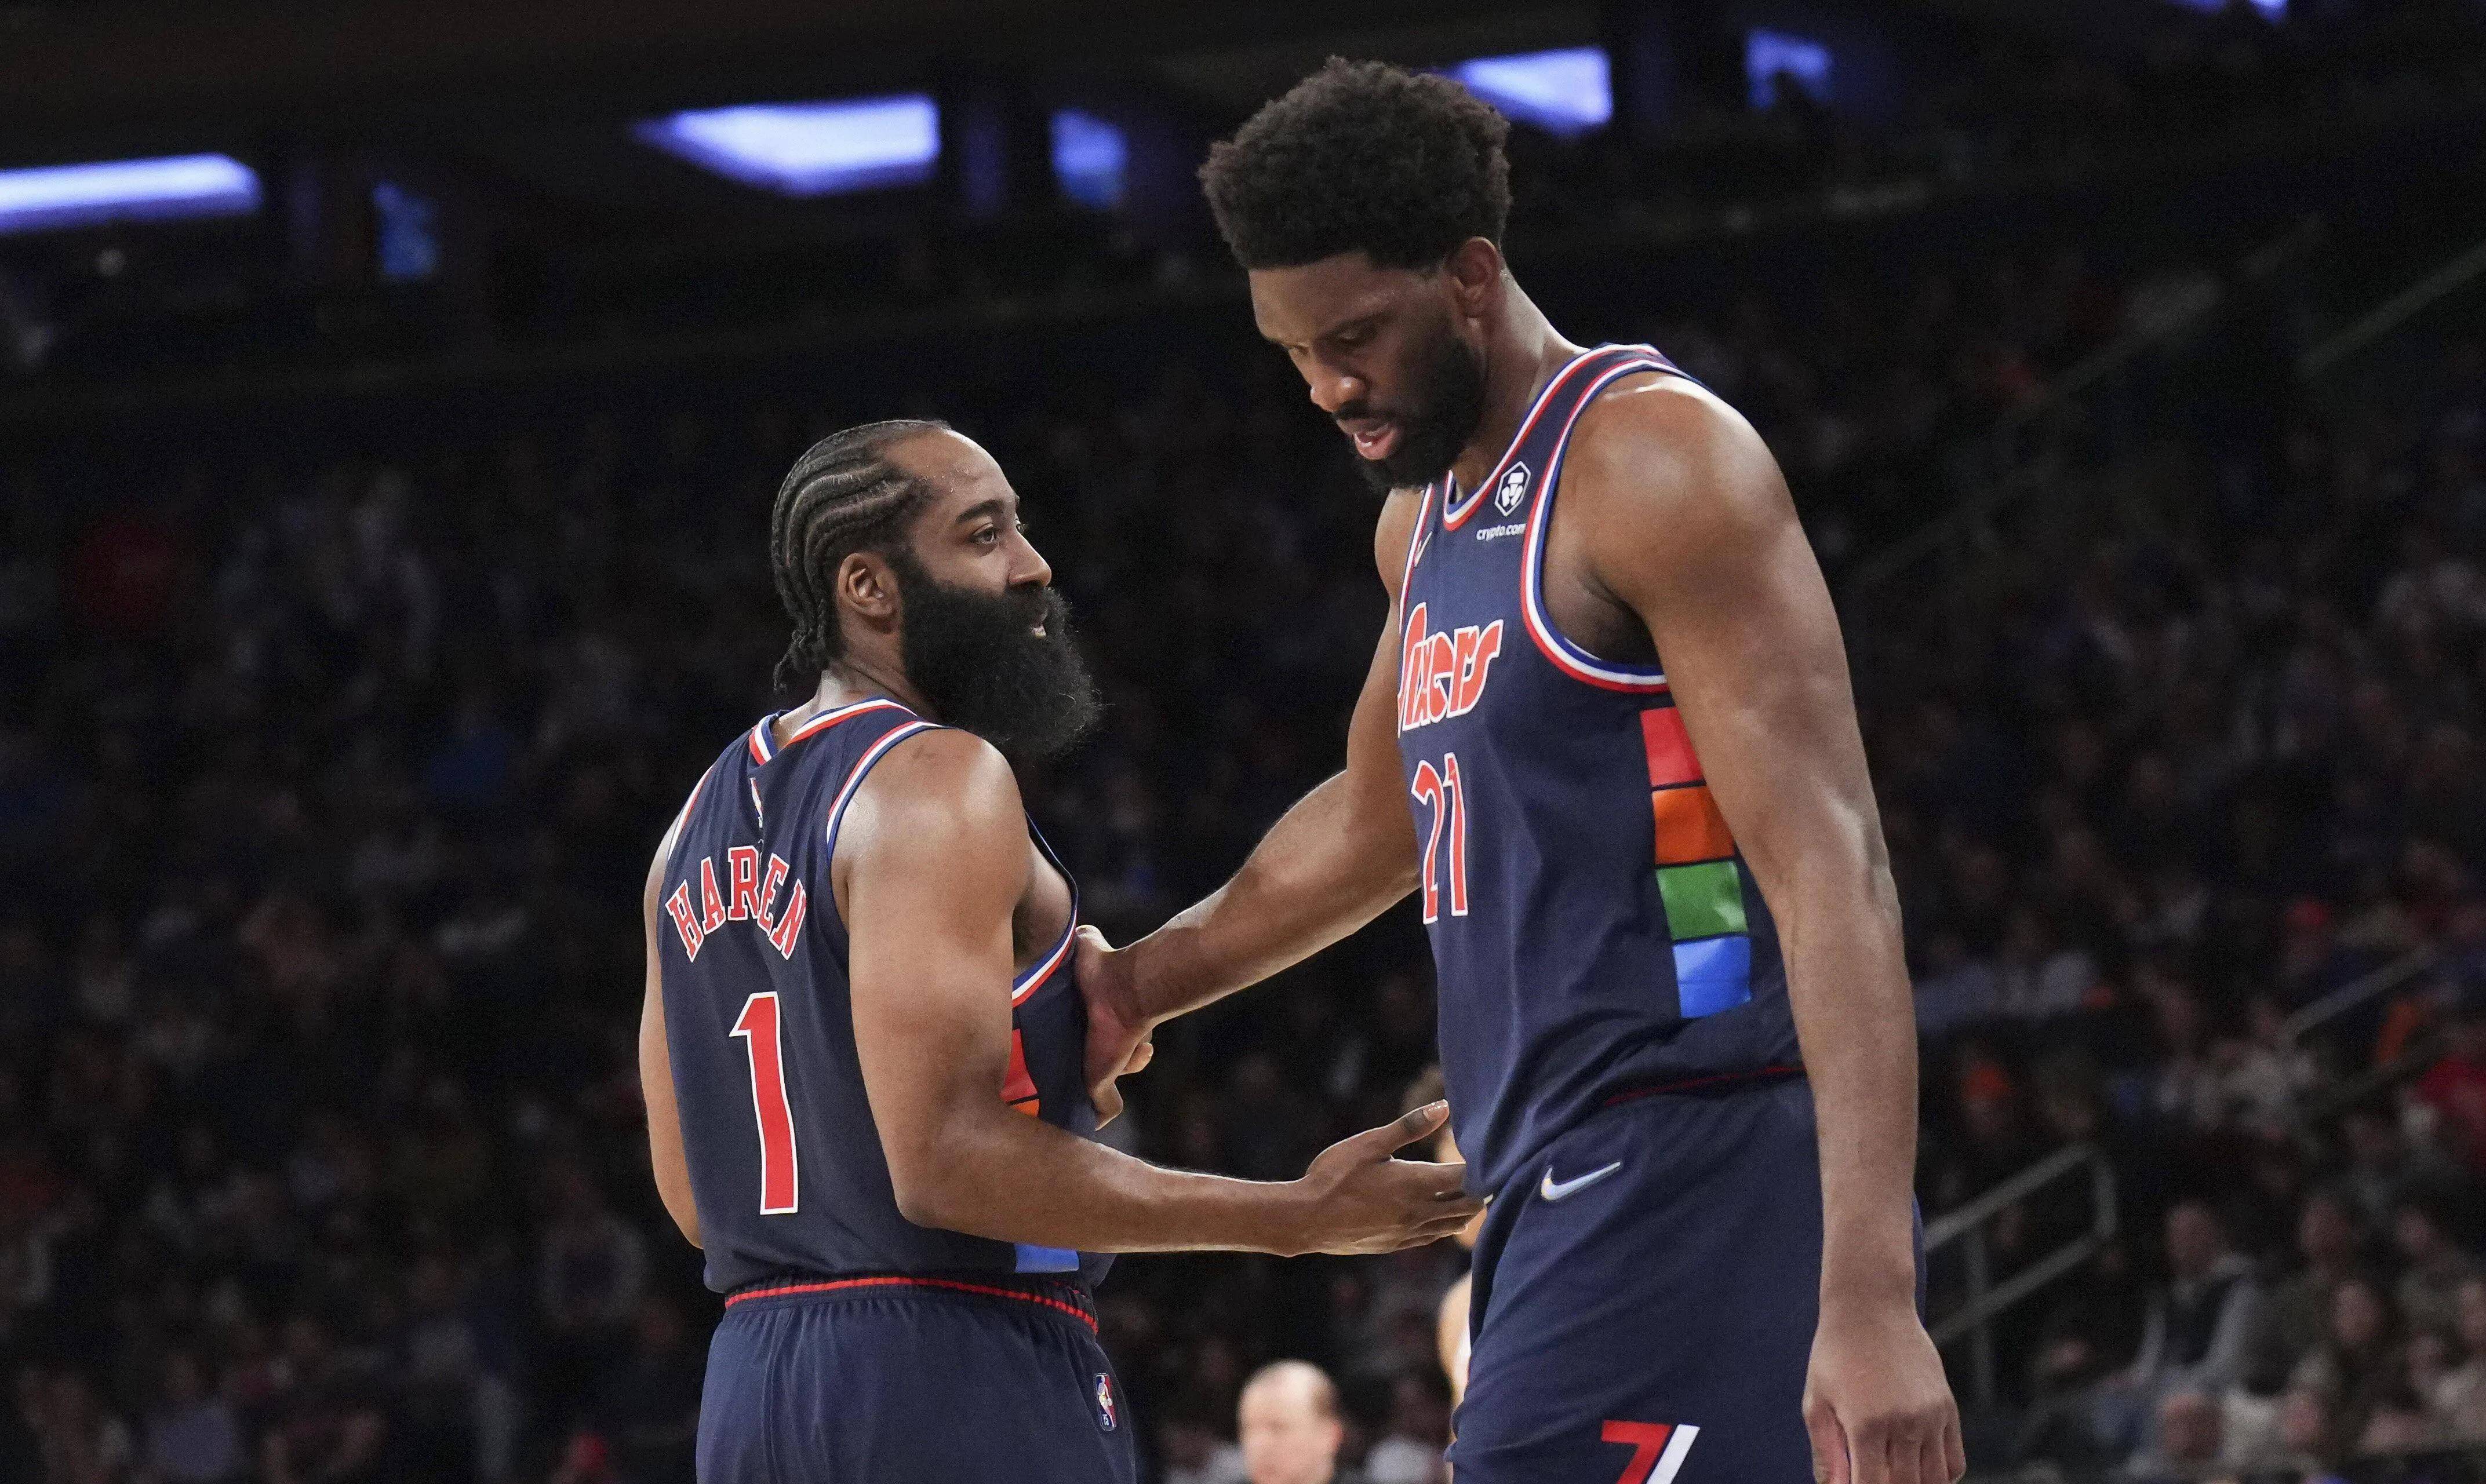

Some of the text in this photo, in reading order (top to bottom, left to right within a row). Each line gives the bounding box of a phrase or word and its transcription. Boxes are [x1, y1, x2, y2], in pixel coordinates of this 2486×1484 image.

[665, 845, 807, 962] HAREN
[1411, 752, 1468, 925] 21
[729, 991, 798, 1215] 1
